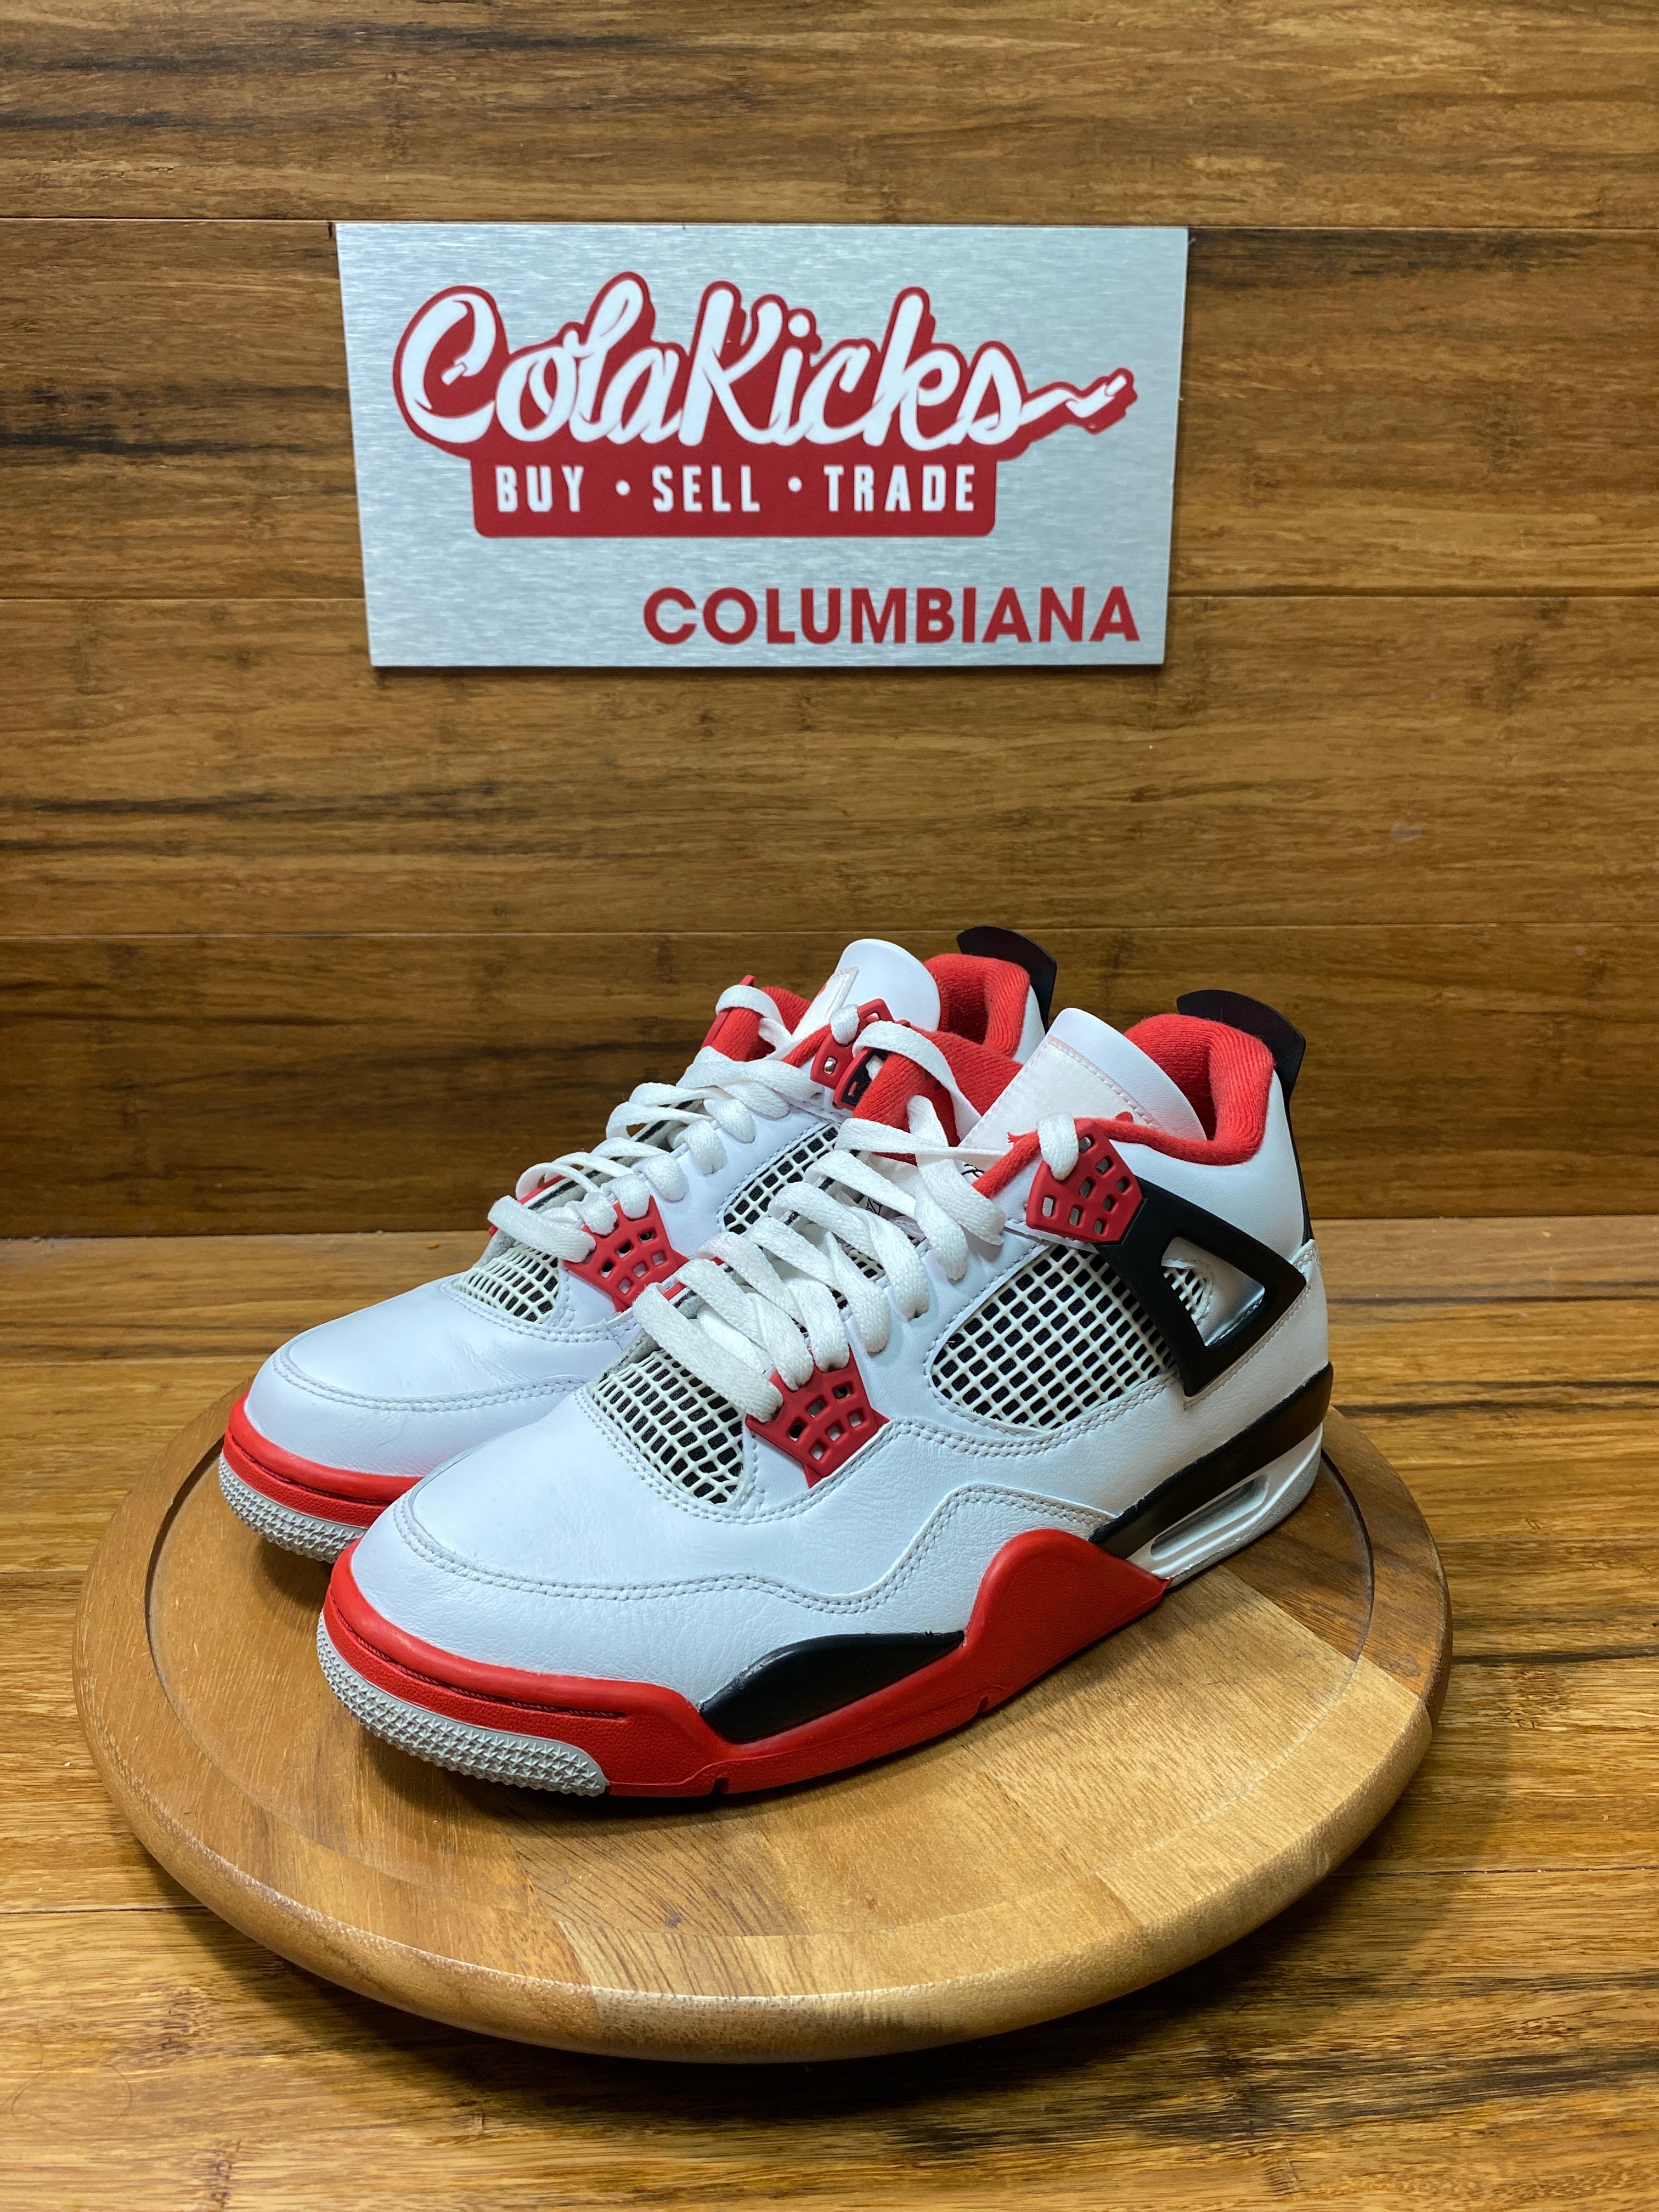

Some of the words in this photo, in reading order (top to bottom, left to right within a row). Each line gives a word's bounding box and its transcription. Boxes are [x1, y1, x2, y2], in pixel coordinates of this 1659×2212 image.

[495, 465, 584, 513] BUY
[652, 465, 761, 513] SELL
[823, 465, 975, 512] TRADE
[644, 586, 1139, 644] COLUMBIANA
